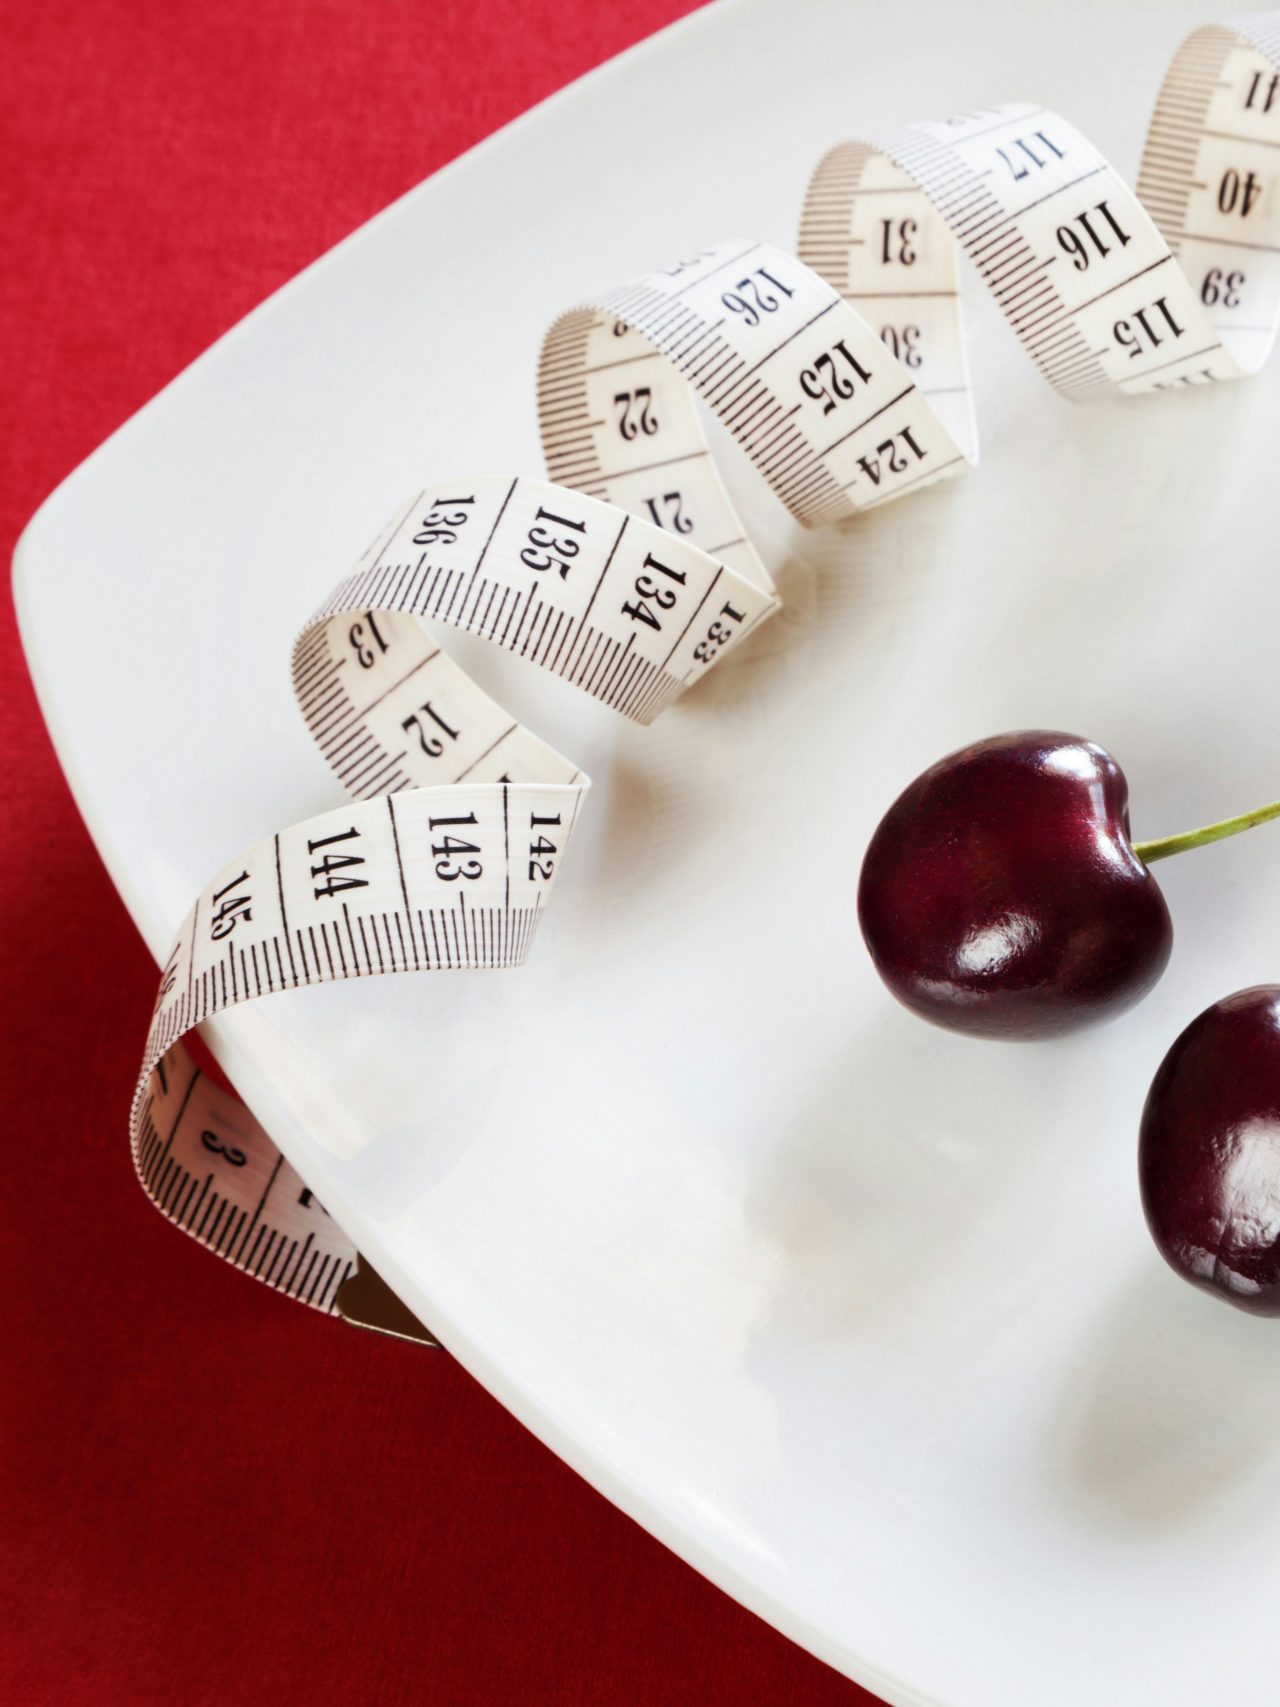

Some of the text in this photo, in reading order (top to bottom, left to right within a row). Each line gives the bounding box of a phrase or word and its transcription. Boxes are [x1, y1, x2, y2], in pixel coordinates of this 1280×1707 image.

[995, 130, 1068, 181] 117
[1217, 168, 1262, 218] 40
[879, 217, 917, 266] 31
[1056, 200, 1132, 272] 116
[721, 266, 796, 327] 126
[1201, 267, 1244, 308] 39
[1113, 297, 1186, 359] 115
[800, 339, 873, 416] 125
[614, 387, 659, 441] 22
[856, 425, 928, 486] 124
[413, 493, 476, 547] 136
[645, 491, 693, 534] 21
[519, 505, 587, 582] 135
[620, 552, 687, 634] 134
[349, 610, 389, 669] 13
[693, 600, 747, 664] 133
[402, 701, 460, 758] 12
[307, 826, 370, 901] 144
[428, 811, 484, 882] 143
[528, 811, 562, 882] 142
[210, 870, 254, 942] 145
[201, 1129, 247, 1168] 3
